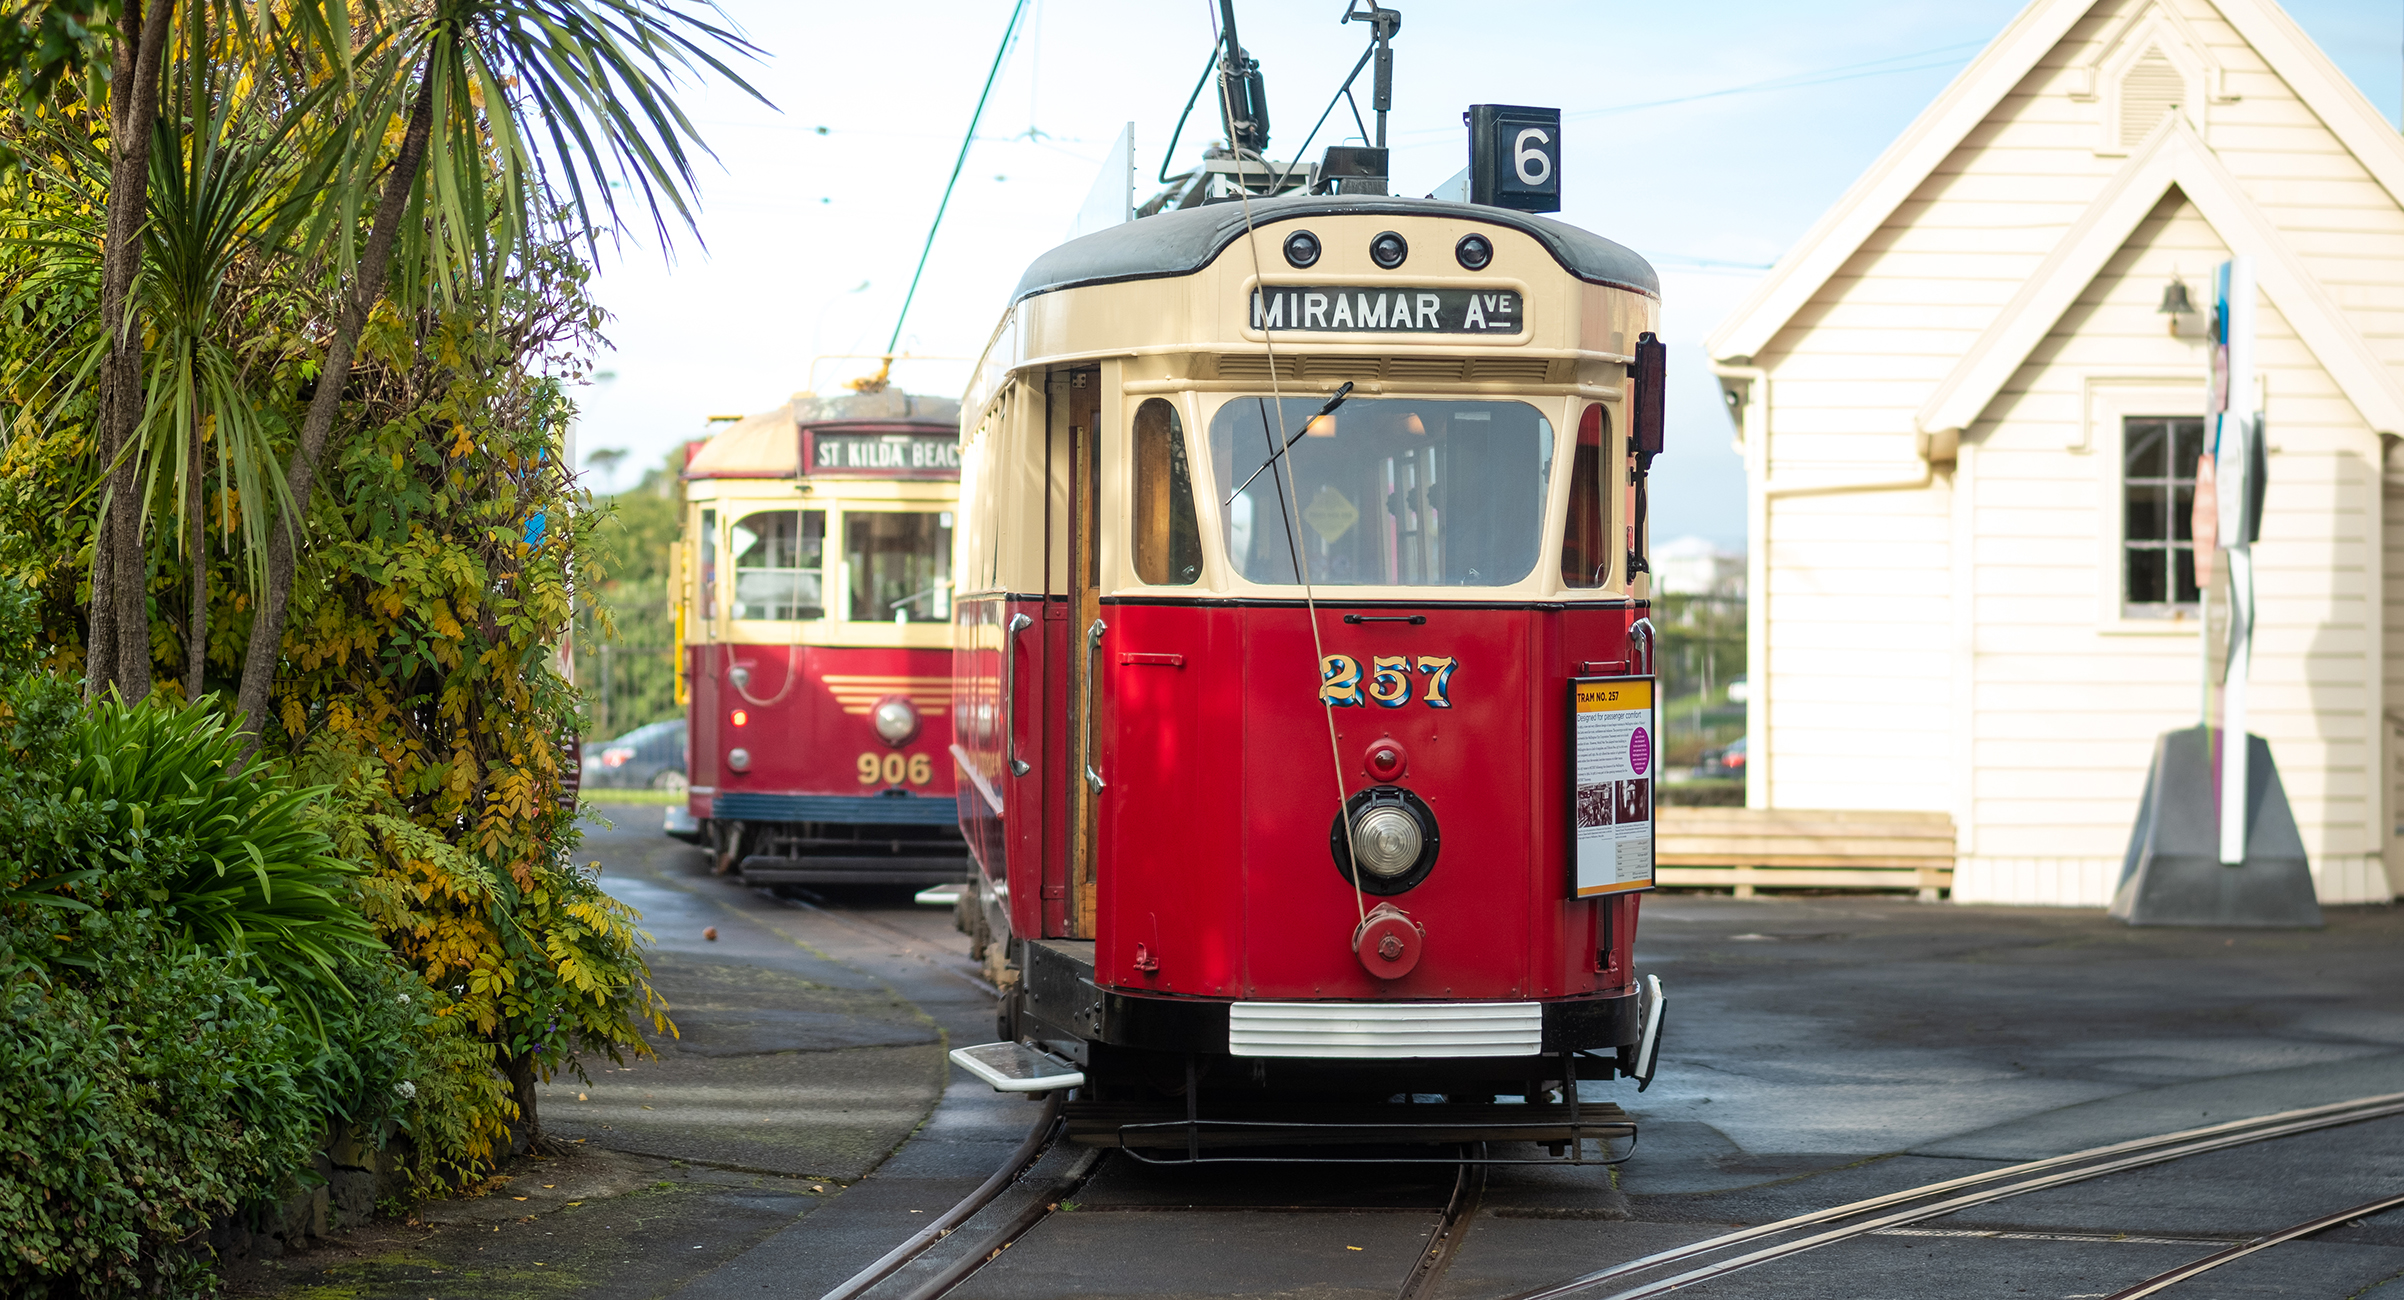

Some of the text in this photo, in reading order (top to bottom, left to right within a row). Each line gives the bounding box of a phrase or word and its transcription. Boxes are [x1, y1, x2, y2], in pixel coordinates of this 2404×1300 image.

[1514, 127, 1551, 186] 6
[1253, 292, 1440, 328] MIRAMAR
[818, 442, 962, 467] ST KILDA BEAC
[1318, 654, 1459, 709] 257
[1577, 691, 1619, 702] TRAM NO. 257
[1577, 713, 1596, 723] Designed
[1604, 712, 1625, 721] passenger
[1625, 711, 1641, 719] comfort
[857, 752, 932, 785] 906
